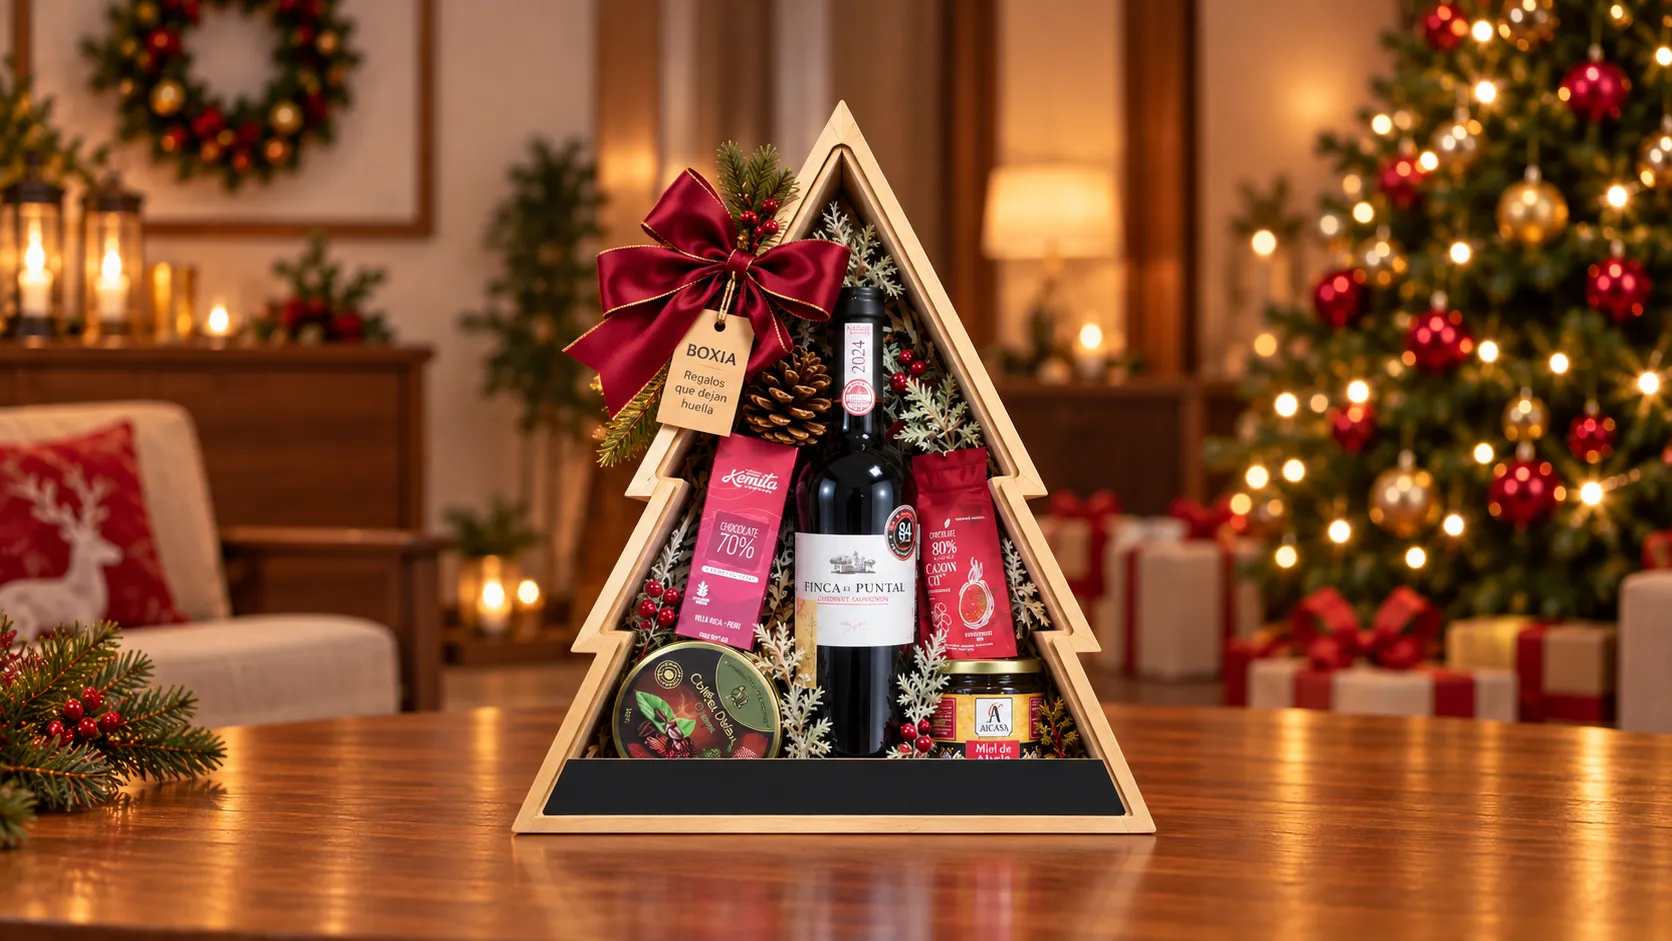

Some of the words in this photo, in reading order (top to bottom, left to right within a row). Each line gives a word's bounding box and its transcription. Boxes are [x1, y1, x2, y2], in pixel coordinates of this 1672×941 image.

[686, 344, 736, 366] BOXIA
[851, 340, 866, 374] 2024
[684, 370, 725, 388] Regalos
[675, 385, 695, 395] que
[698, 388, 727, 403] dejan
[681, 398, 713, 415] huella
[721, 469, 778, 490] Kemita
[720, 521, 758, 538] CHOCOLATE
[716, 532, 755, 559] 70%
[931, 539, 957, 556] 80%
[804, 581, 841, 593] FINCA
[856, 582, 906, 593] PUNTAL
[999, 743, 1012, 754] de
